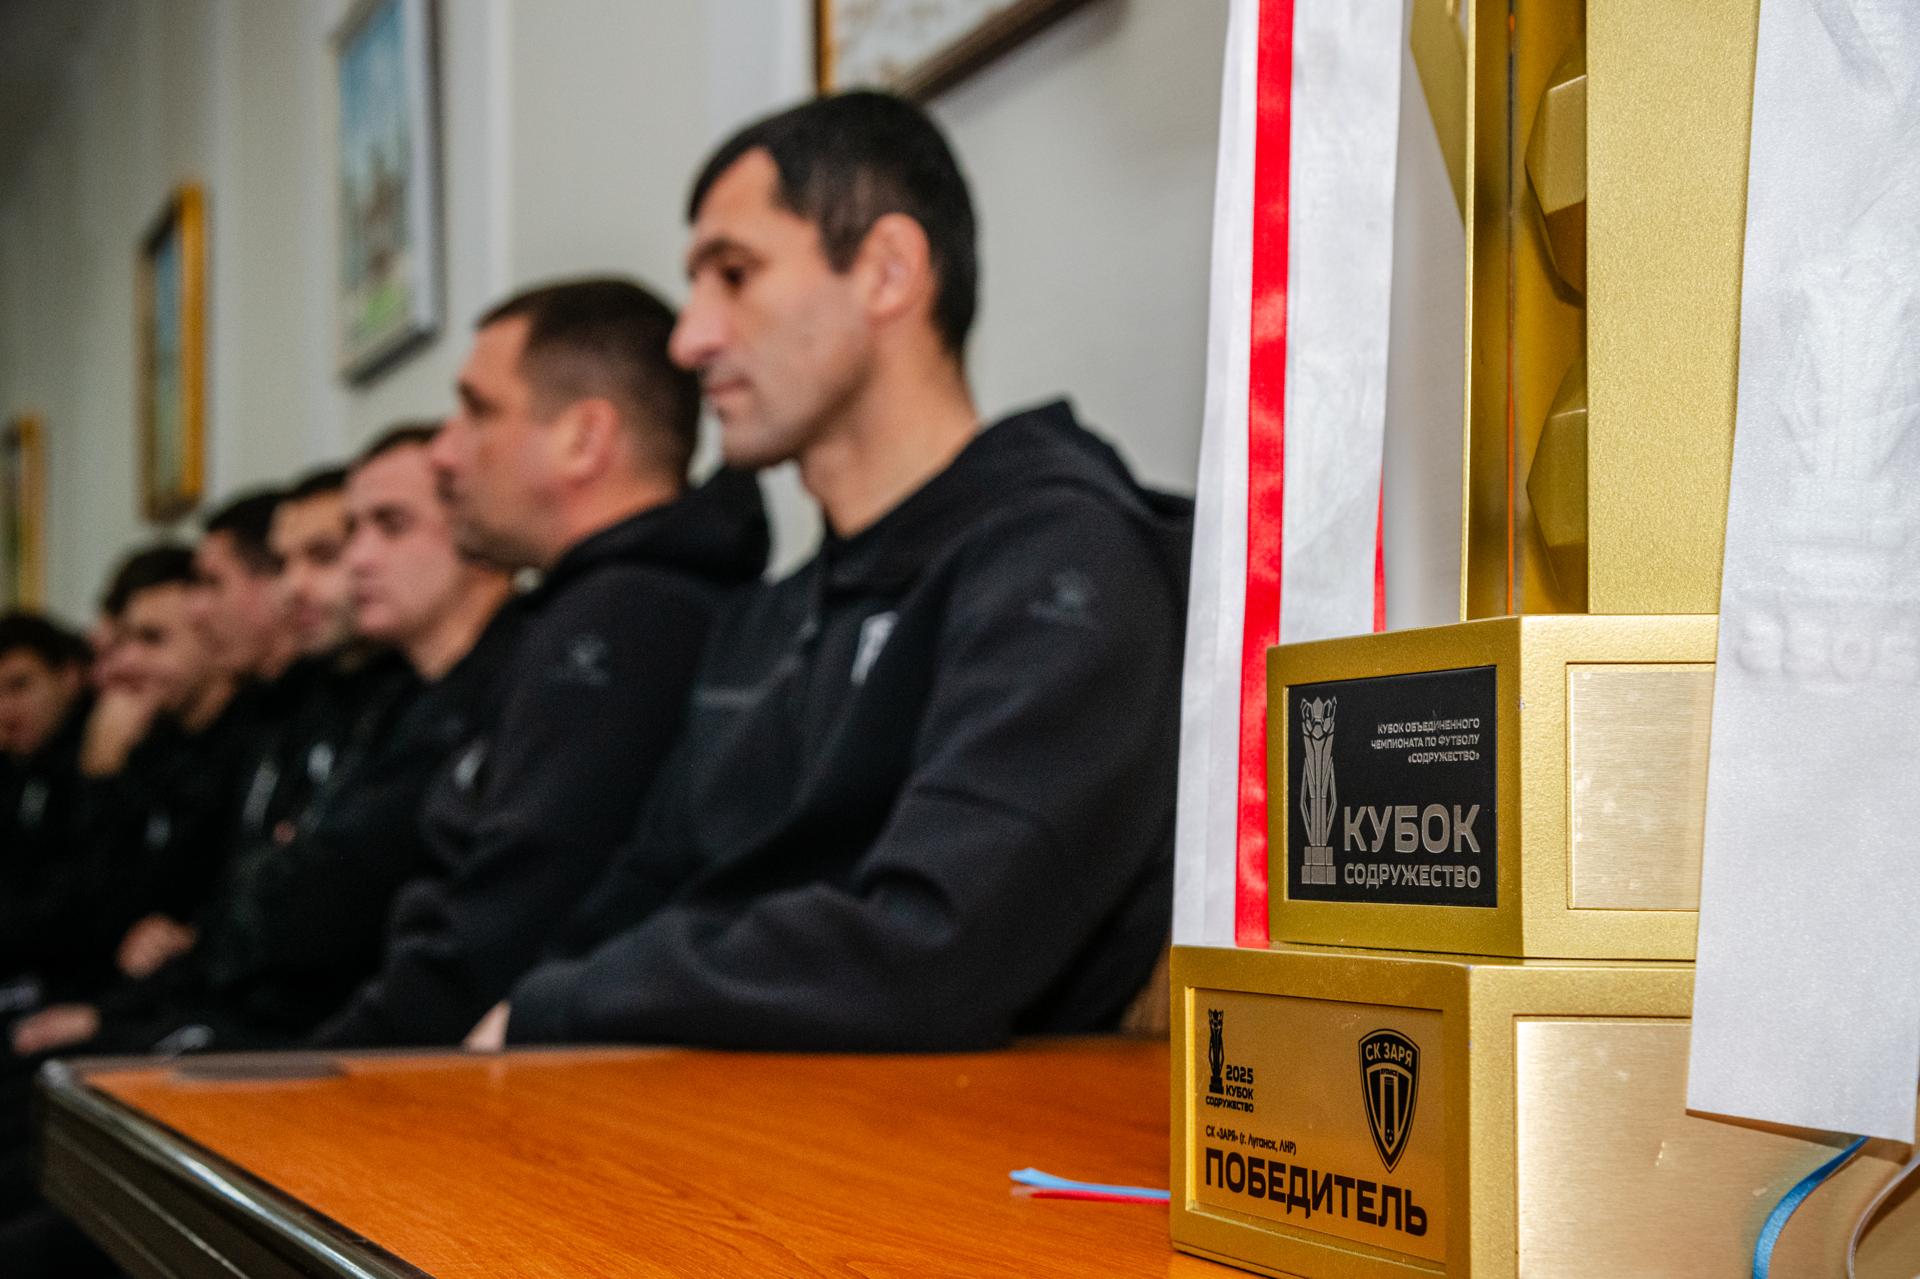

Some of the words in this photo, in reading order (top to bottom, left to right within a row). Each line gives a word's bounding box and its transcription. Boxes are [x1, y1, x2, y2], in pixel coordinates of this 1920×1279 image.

[1377, 722, 1404, 734] КУБОК
[1405, 718, 1480, 733] ОБЪЕДИНЕННОГО
[1371, 738, 1424, 749] ЧЕМПИОНАТА
[1425, 736, 1437, 747] ПО
[1438, 734, 1480, 746] ФУТБОЛУ
[1407, 750, 1480, 764] «СОДРУЖЕСТВО»
[1343, 804, 1480, 853] КУБОК
[1344, 863, 1481, 889] СОДРУЖЕСТВО
[1365, 1042, 1381, 1061] СК
[1383, 1042, 1413, 1067] ЗАРЯ
[1226, 1064, 1254, 1084] 2025
[1226, 1084, 1254, 1100] КУБОК
[1206, 1096, 1254, 1112] СОДРУЖЕСТВО
[1206, 1125, 1215, 1138] СК
[1279, 1139, 1297, 1156] ЛНР)
[1205, 1147, 1428, 1237] ПОБЕДИТЕЛЬ
